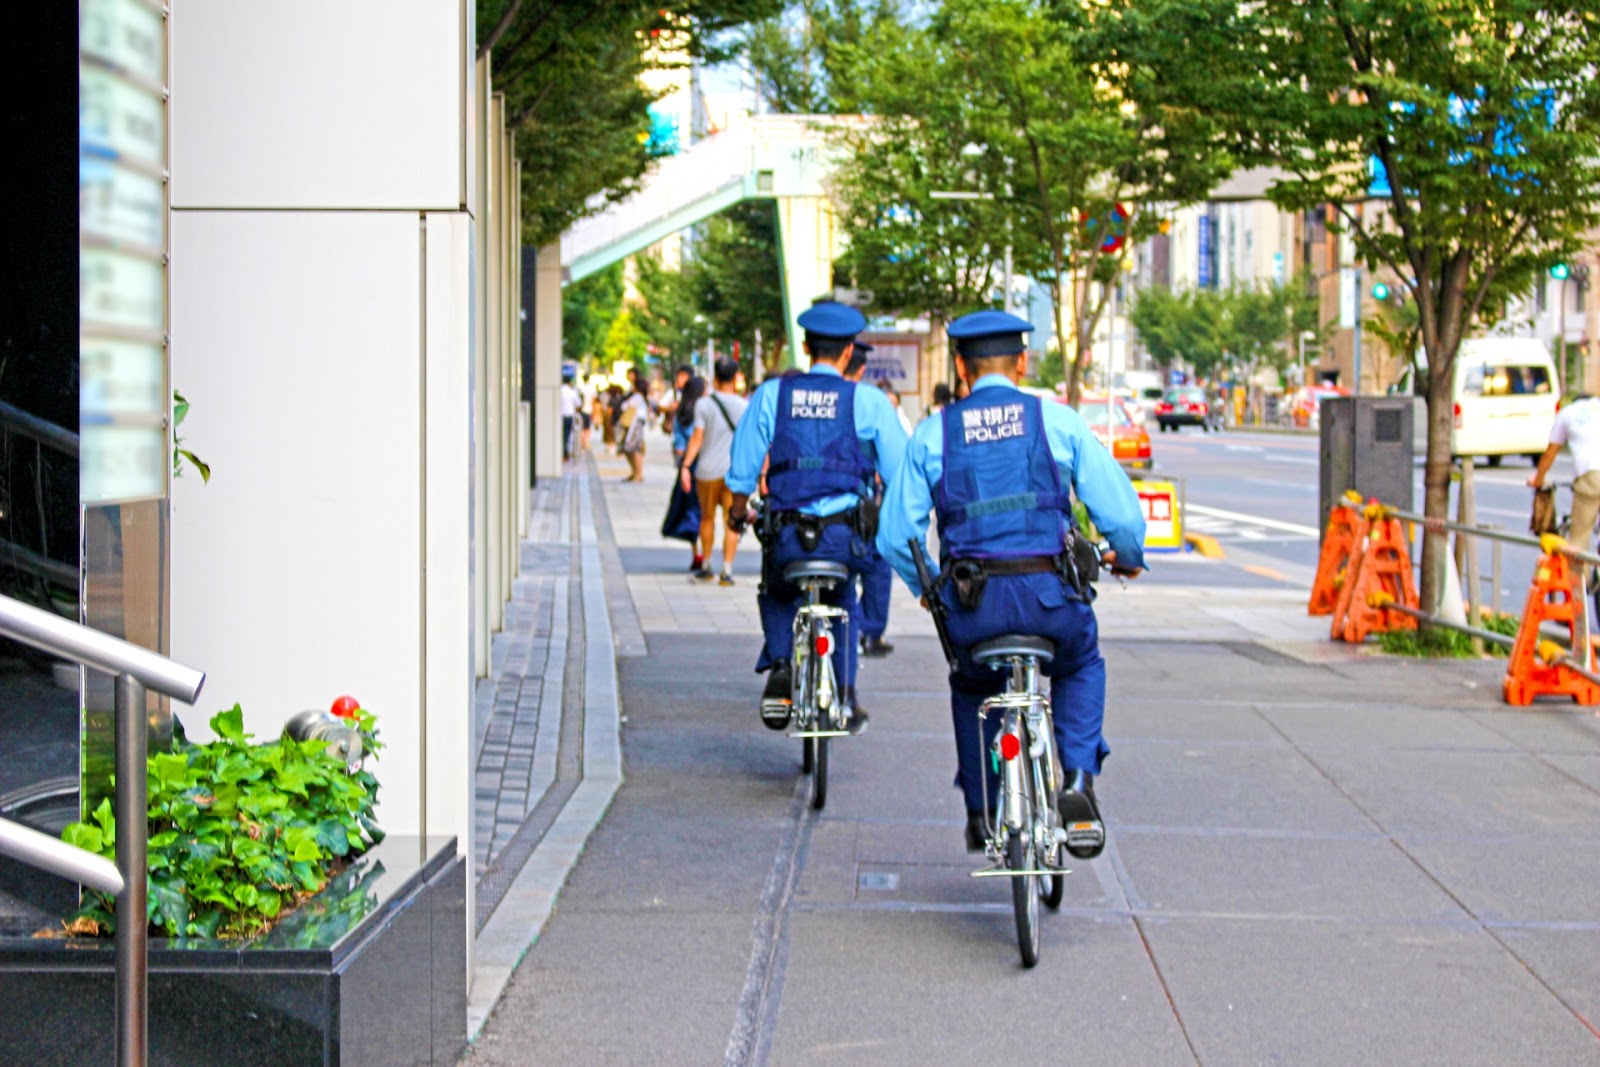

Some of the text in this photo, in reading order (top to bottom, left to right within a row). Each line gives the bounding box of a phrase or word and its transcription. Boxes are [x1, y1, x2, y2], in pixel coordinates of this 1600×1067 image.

[792, 389, 839, 406] 警視庁
[791, 405, 836, 419] POLICE
[962, 404, 1024, 428] 警視庁
[964, 421, 1024, 444] POLICE
